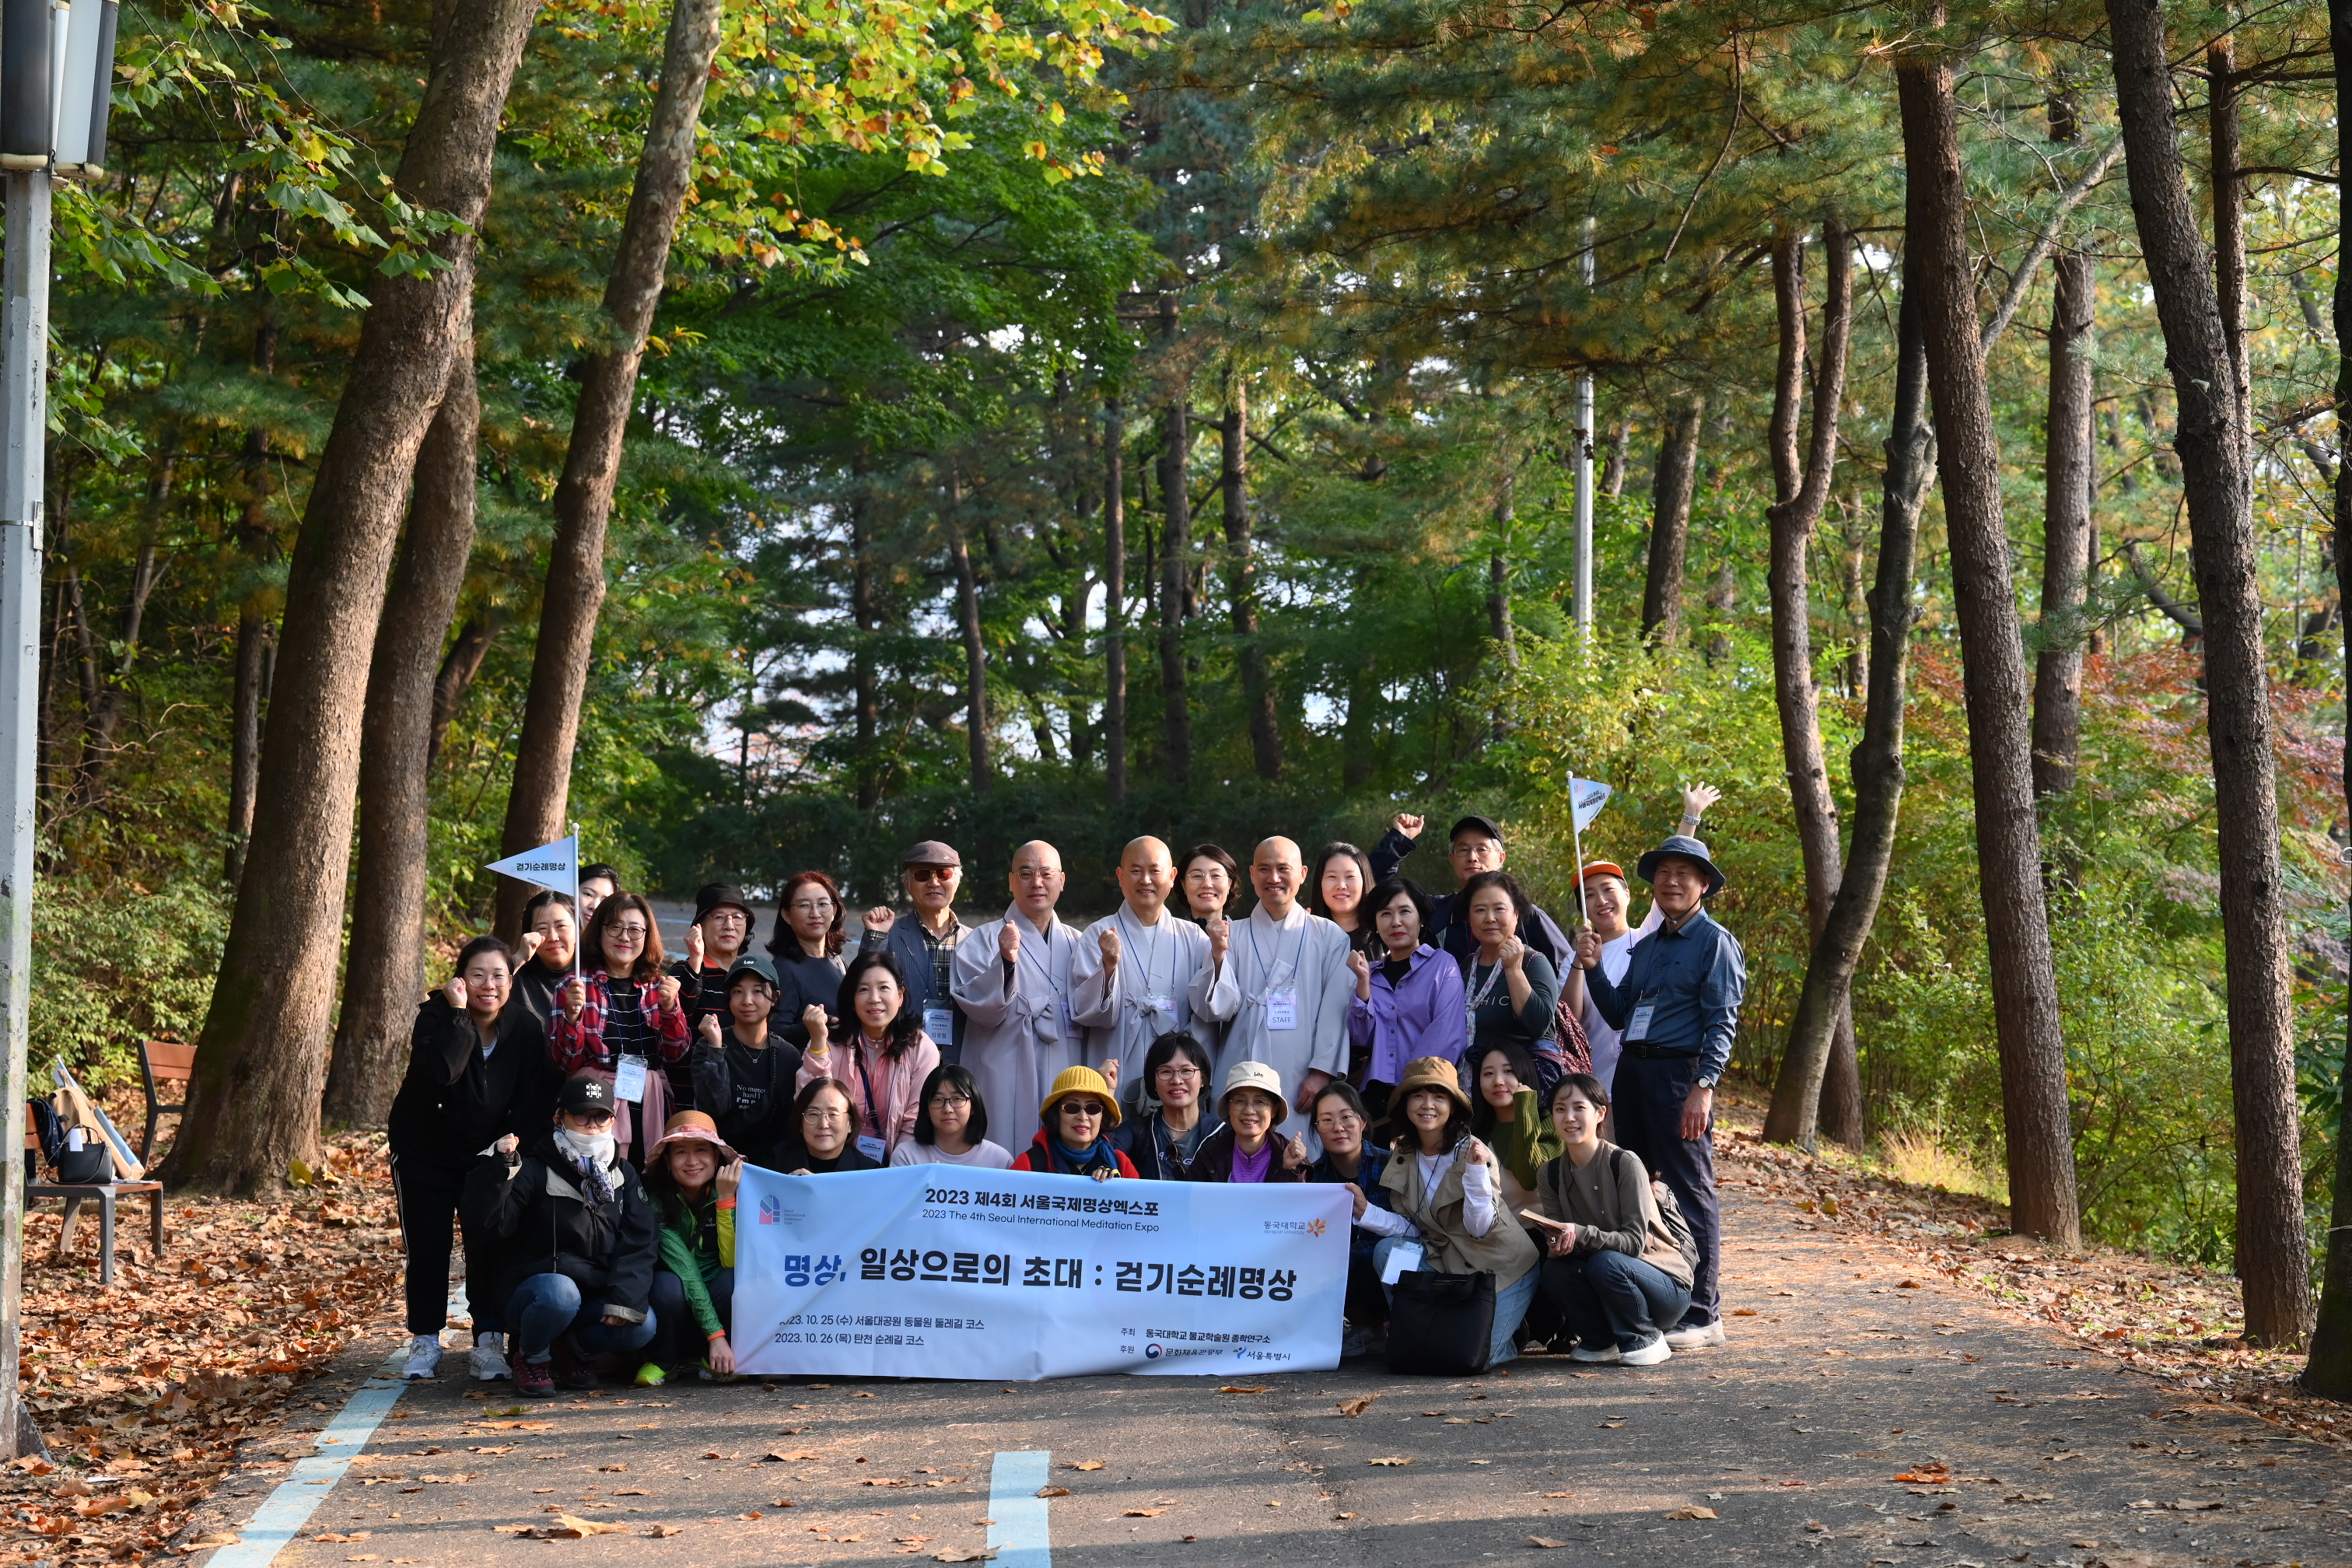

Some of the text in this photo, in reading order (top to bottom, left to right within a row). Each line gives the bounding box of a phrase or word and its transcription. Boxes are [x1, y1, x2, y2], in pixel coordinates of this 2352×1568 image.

[516, 863, 566, 871] 걷기순례명상
[925, 1188, 1159, 1216] 2023 제4회 서울국제명상엑스포
[922, 1209, 1160, 1234] 2023 The 4th Seoul International Meditation Expo
[1264, 1221, 1305, 1230] 동국대학교
[785, 1248, 1297, 1301] 명상, 일상으로의 초대 : 걷기순례명상
[806, 1314, 818, 1325] 10.
[821, 1314, 834, 1325] 25
[836, 1314, 852, 1325] (수)
[855, 1315, 901, 1327] 서울대공원
[904, 1317, 933, 1328] 동물원
[935, 1318, 963, 1329] 둘레길
[965, 1319, 985, 1330] 코스
[775, 1332, 925, 1346] 2023. 10. 26 (목) 탄천 순례길 코스
[1121, 1328, 1270, 1343] 주최 동국대학교 불교학술원 종학연구소
[1120, 1345, 1291, 1360] 후원 문화체육관광부 서울특별시
